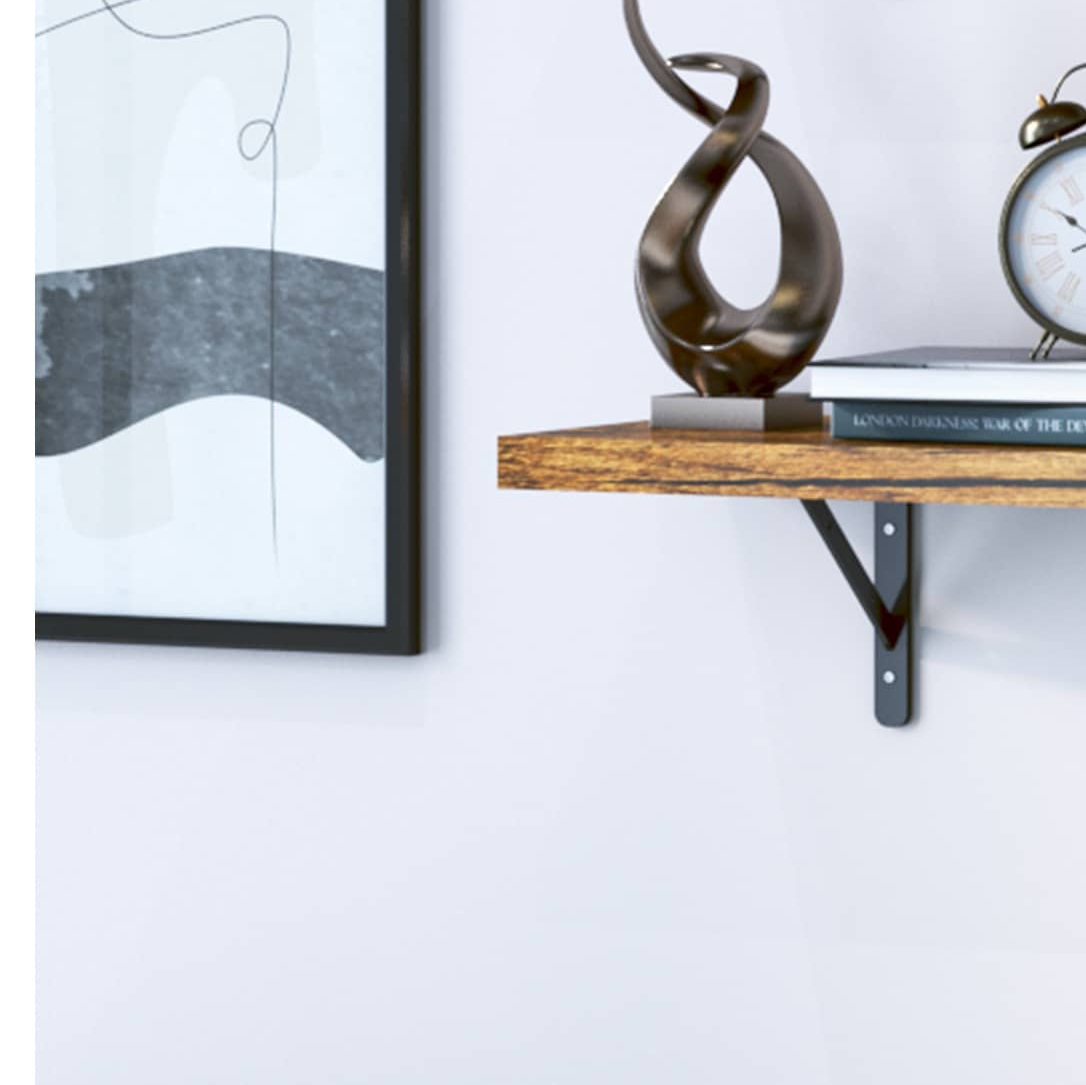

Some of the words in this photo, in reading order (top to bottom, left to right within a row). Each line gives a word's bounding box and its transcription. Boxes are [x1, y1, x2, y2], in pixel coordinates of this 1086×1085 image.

[853, 413, 909, 427] LONDON
[982, 416, 1011, 431] WAR
[1014, 417, 1034, 432] OF
[1037, 418, 1063, 433] THE
